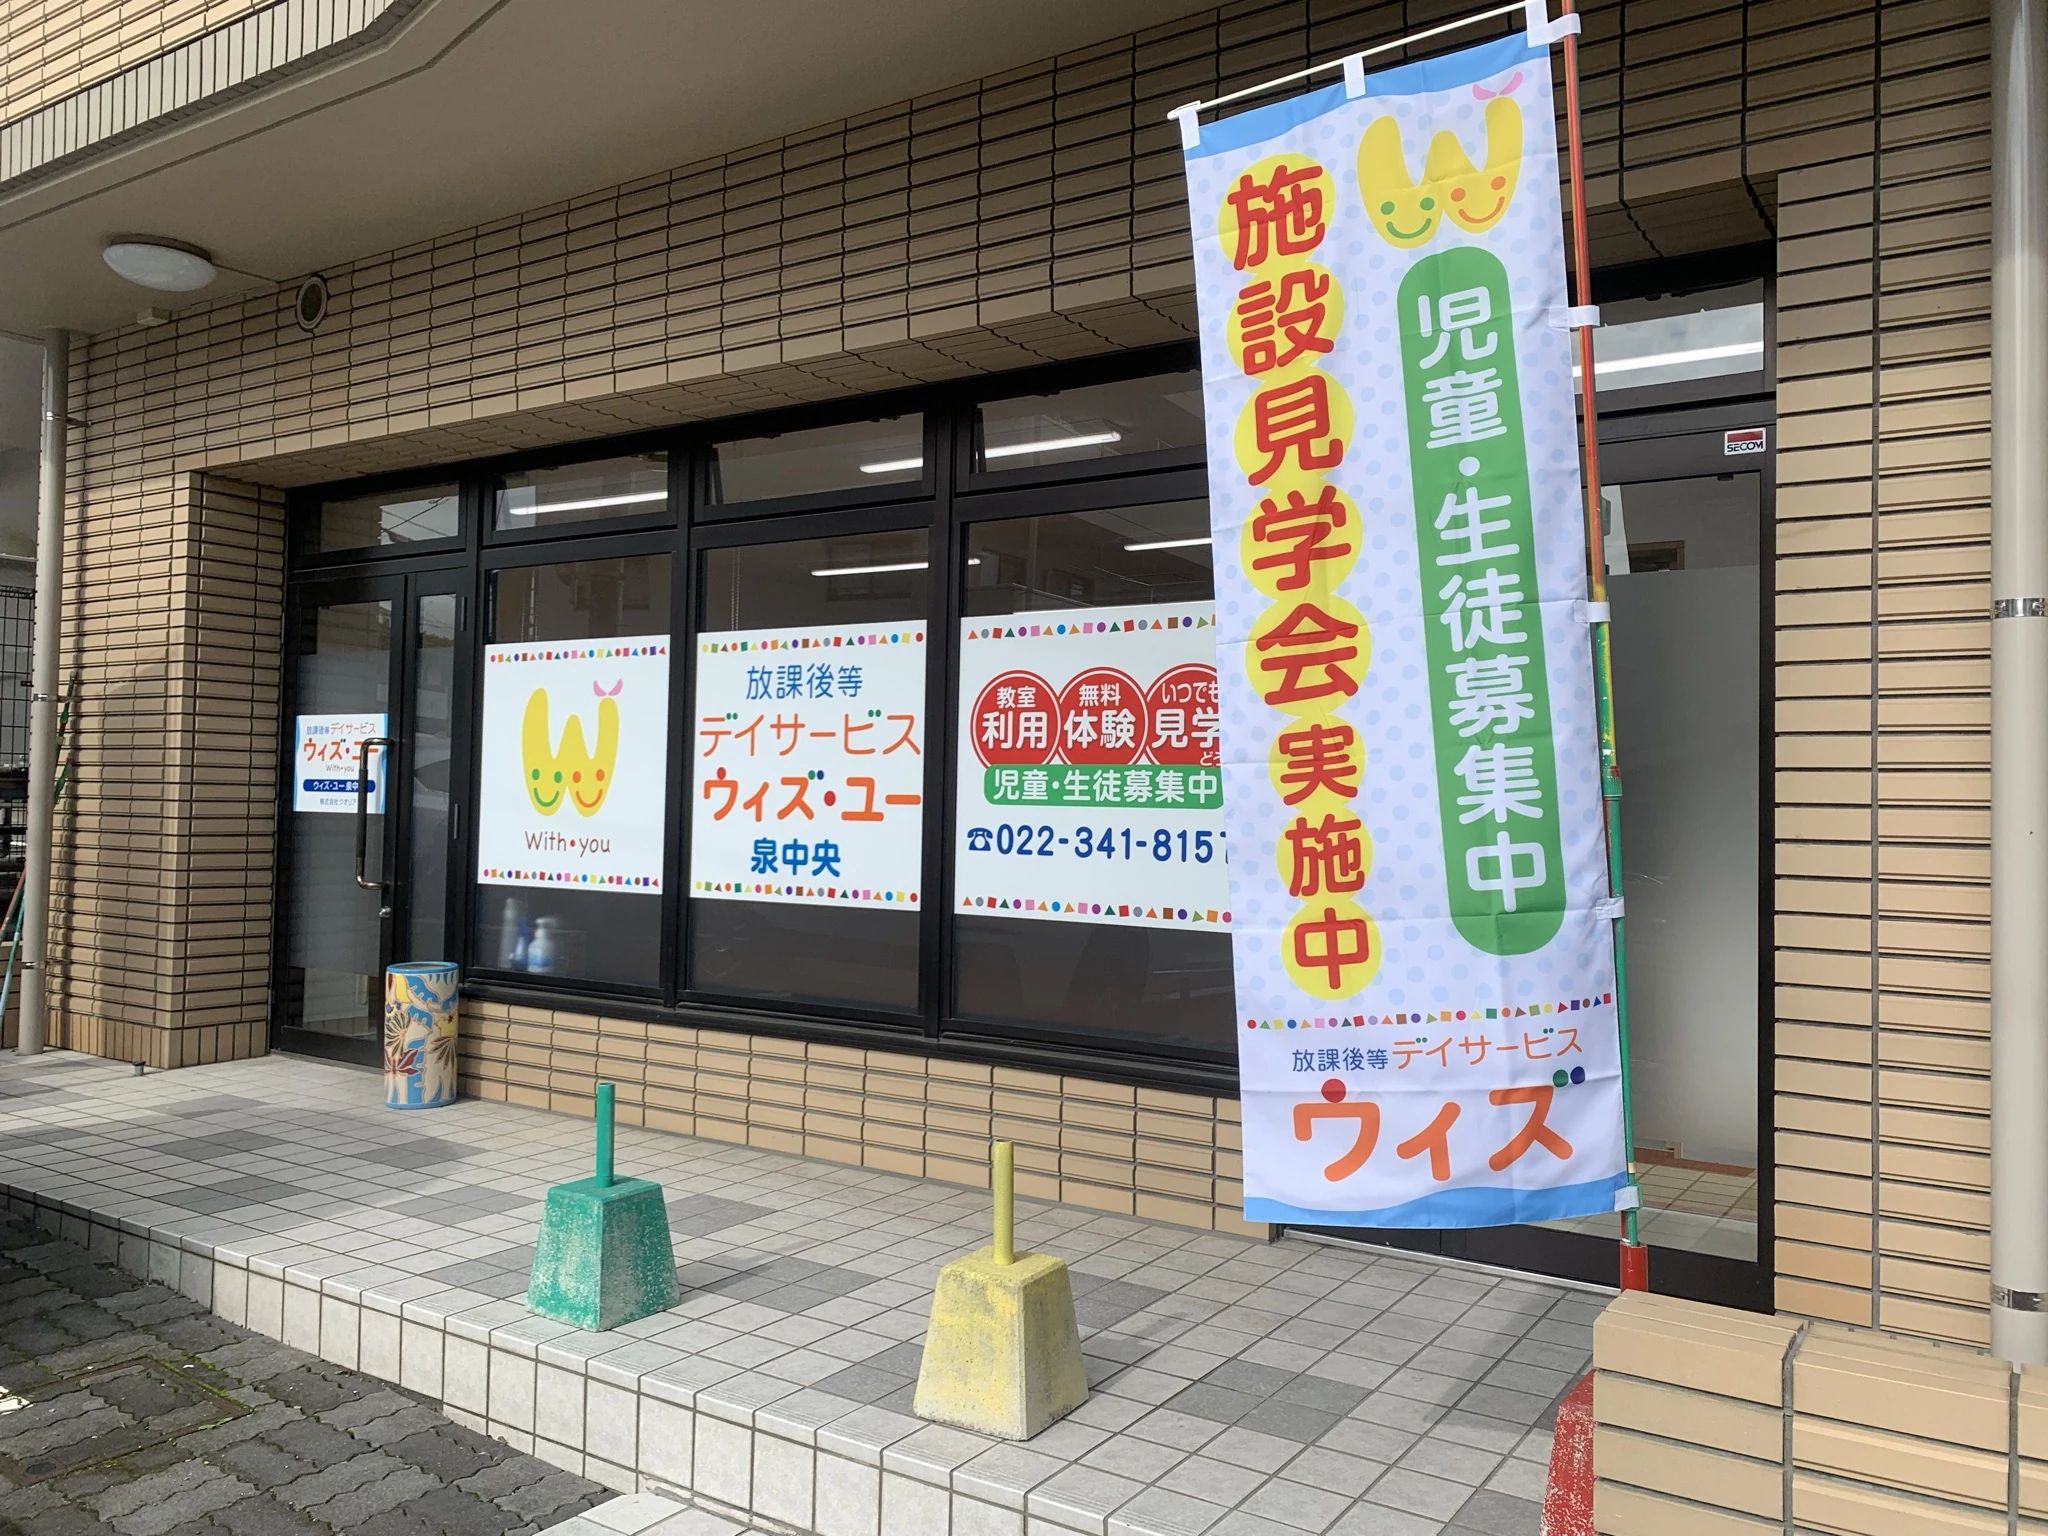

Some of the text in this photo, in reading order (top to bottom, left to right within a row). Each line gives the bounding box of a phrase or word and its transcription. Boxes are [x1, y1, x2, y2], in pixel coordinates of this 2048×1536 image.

[1726, 441, 1764, 453] SECOM
[1229, 165, 1369, 988] 施設見学会実施中
[1418, 286, 1547, 913] 児童・生徒募集中
[746, 662, 864, 700] 放課後等
[996, 685, 1036, 709] 教室
[1078, 682, 1122, 707] 無料
[698, 708, 922, 758] デイサービス
[981, 710, 1048, 750] 利用
[1063, 708, 1137, 750] 体験
[1151, 706, 1220, 749] 見学
[703, 766, 922, 823] ウィズ・ユー
[992, 769, 1218, 804] 児童・生徒募集中
[750, 836, 842, 878] 泉中央
[1292, 1066, 1586, 1183] ウィズ
